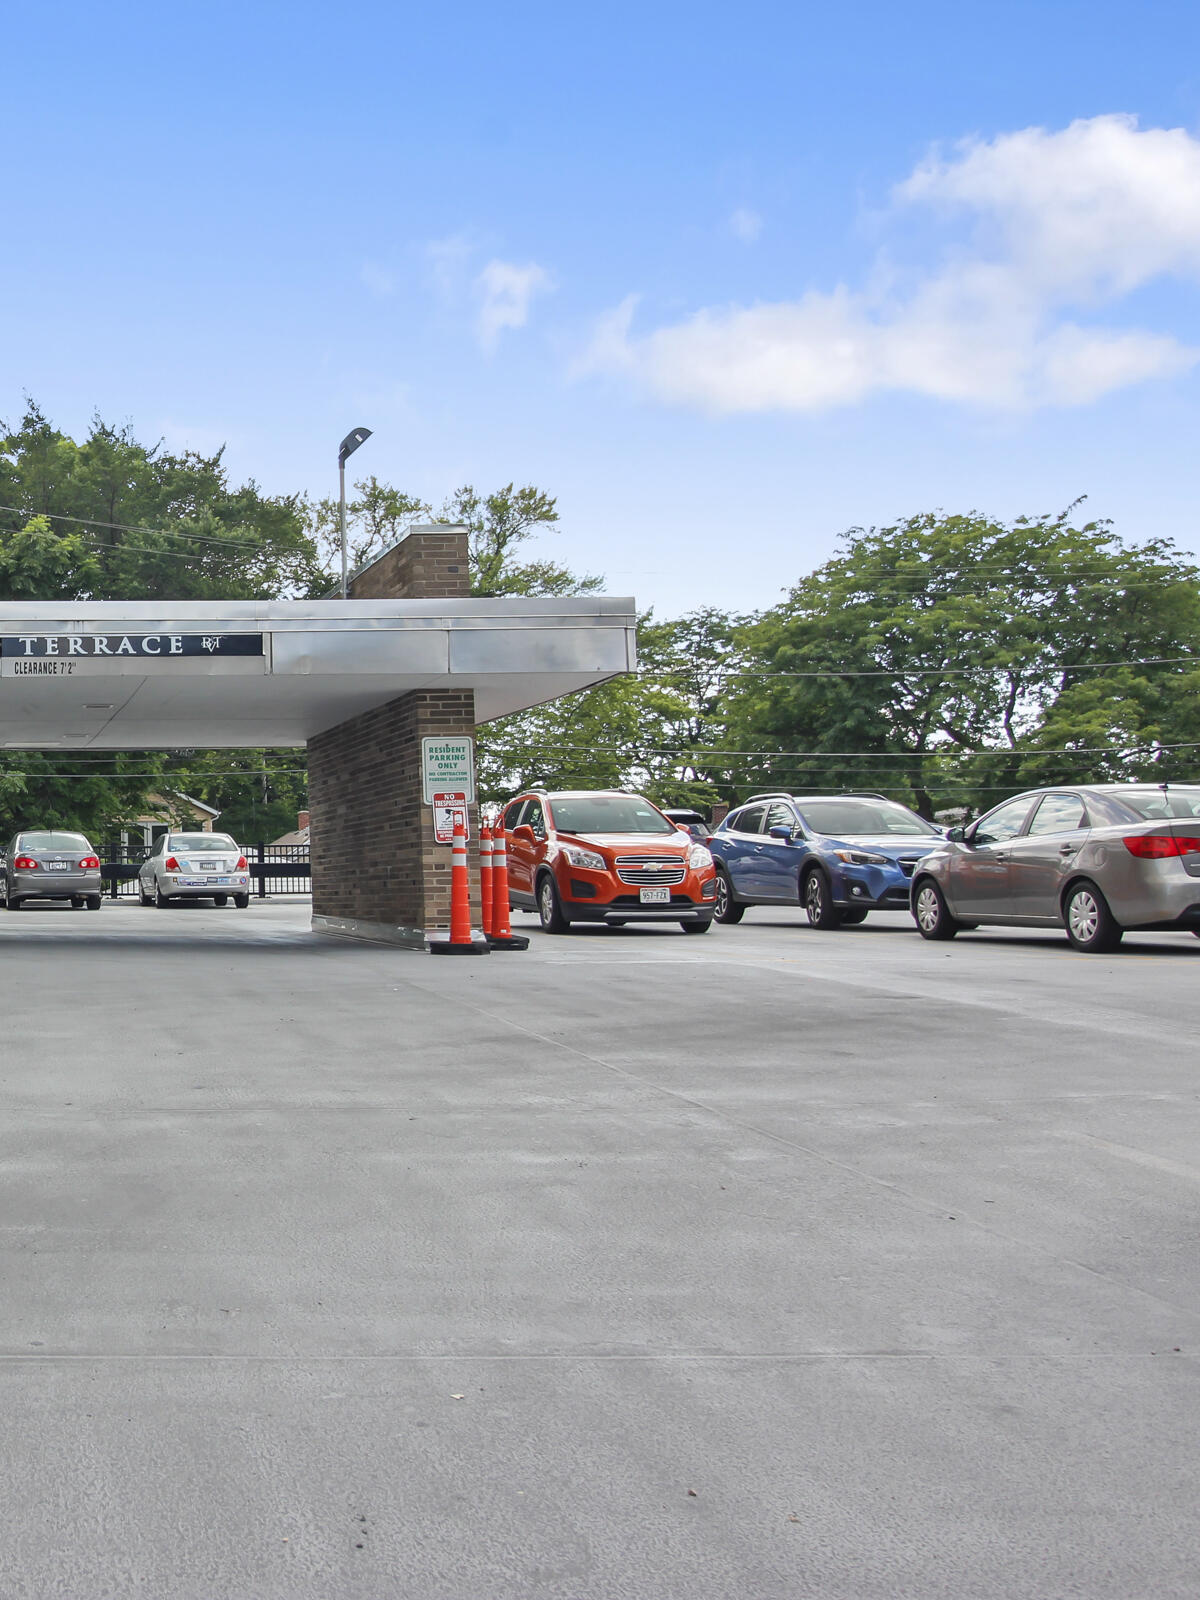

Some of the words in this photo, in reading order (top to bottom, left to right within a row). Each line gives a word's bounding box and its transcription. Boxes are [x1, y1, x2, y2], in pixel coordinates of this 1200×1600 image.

[19, 636, 183, 655] TERRACE
[14, 661, 57, 675] CLEARANCE
[60, 661, 77, 675] 7'2"
[642, 892, 667, 900] 957-FZX
